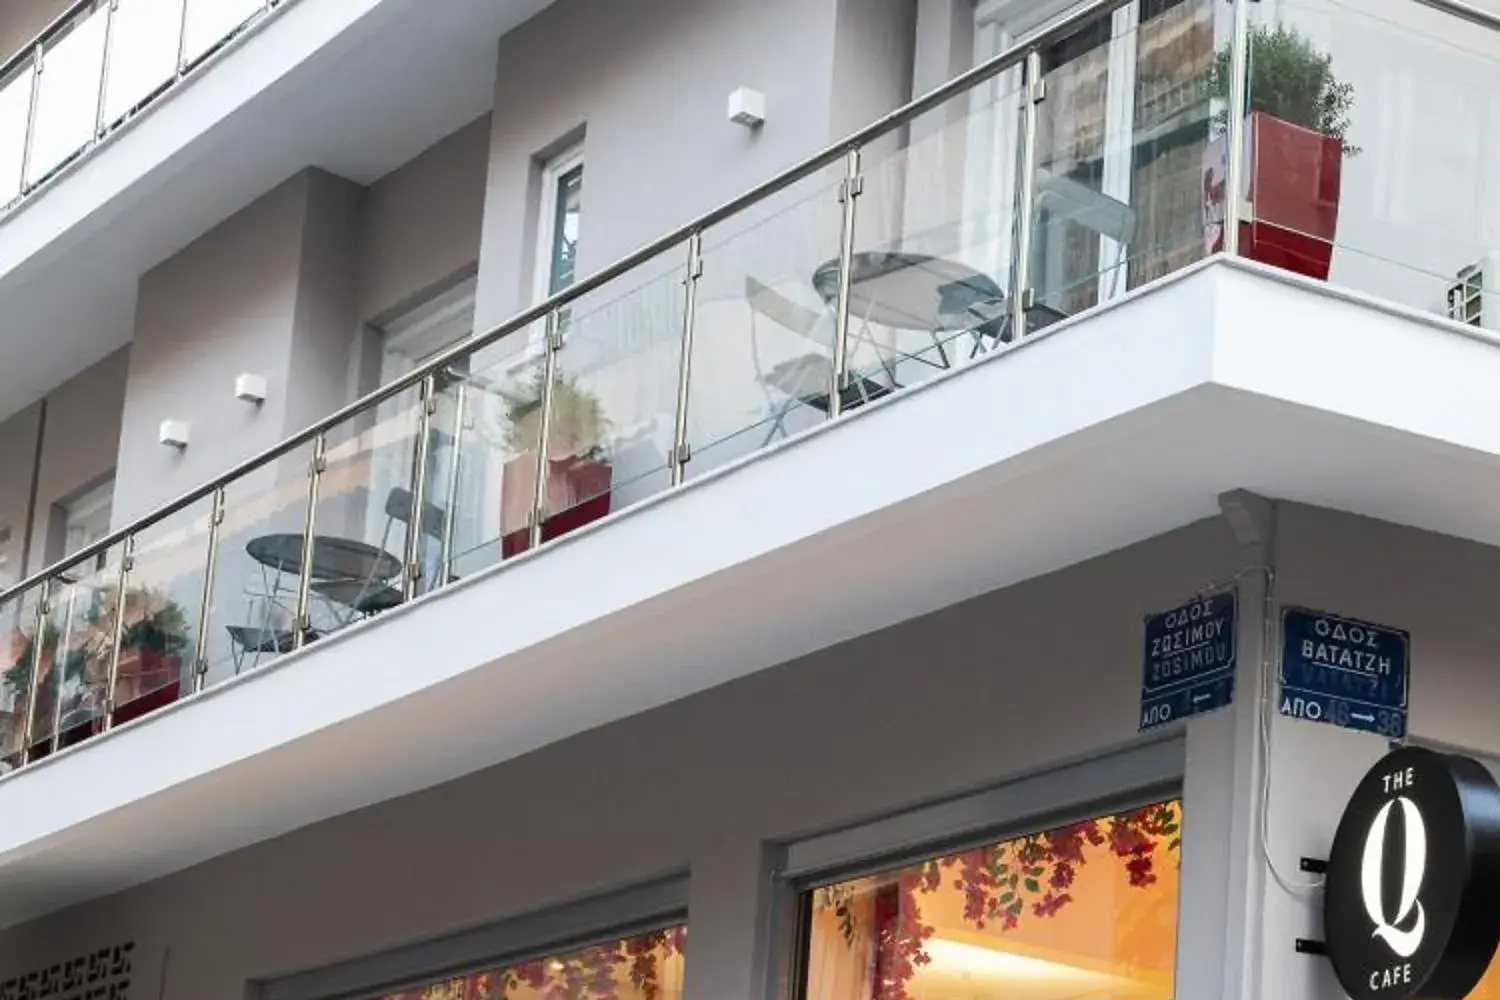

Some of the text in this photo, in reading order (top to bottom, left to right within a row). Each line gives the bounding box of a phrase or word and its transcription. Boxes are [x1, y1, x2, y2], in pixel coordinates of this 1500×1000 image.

[1165, 600, 1213, 629] ΟΔΟΣ
[1152, 617, 1224, 657] ΖΩΣΙΜΟΥ
[1315, 619, 1378, 648] ΟΔΟΣ
[1301, 639, 1391, 675] ΒΑΤΑΤΖΗ
[1281, 697, 1322, 719] ΑΠΟ
[1382, 767, 1414, 793] THE
[1361, 797, 1427, 957] Q
[1369, 963, 1411, 991] CAFE
